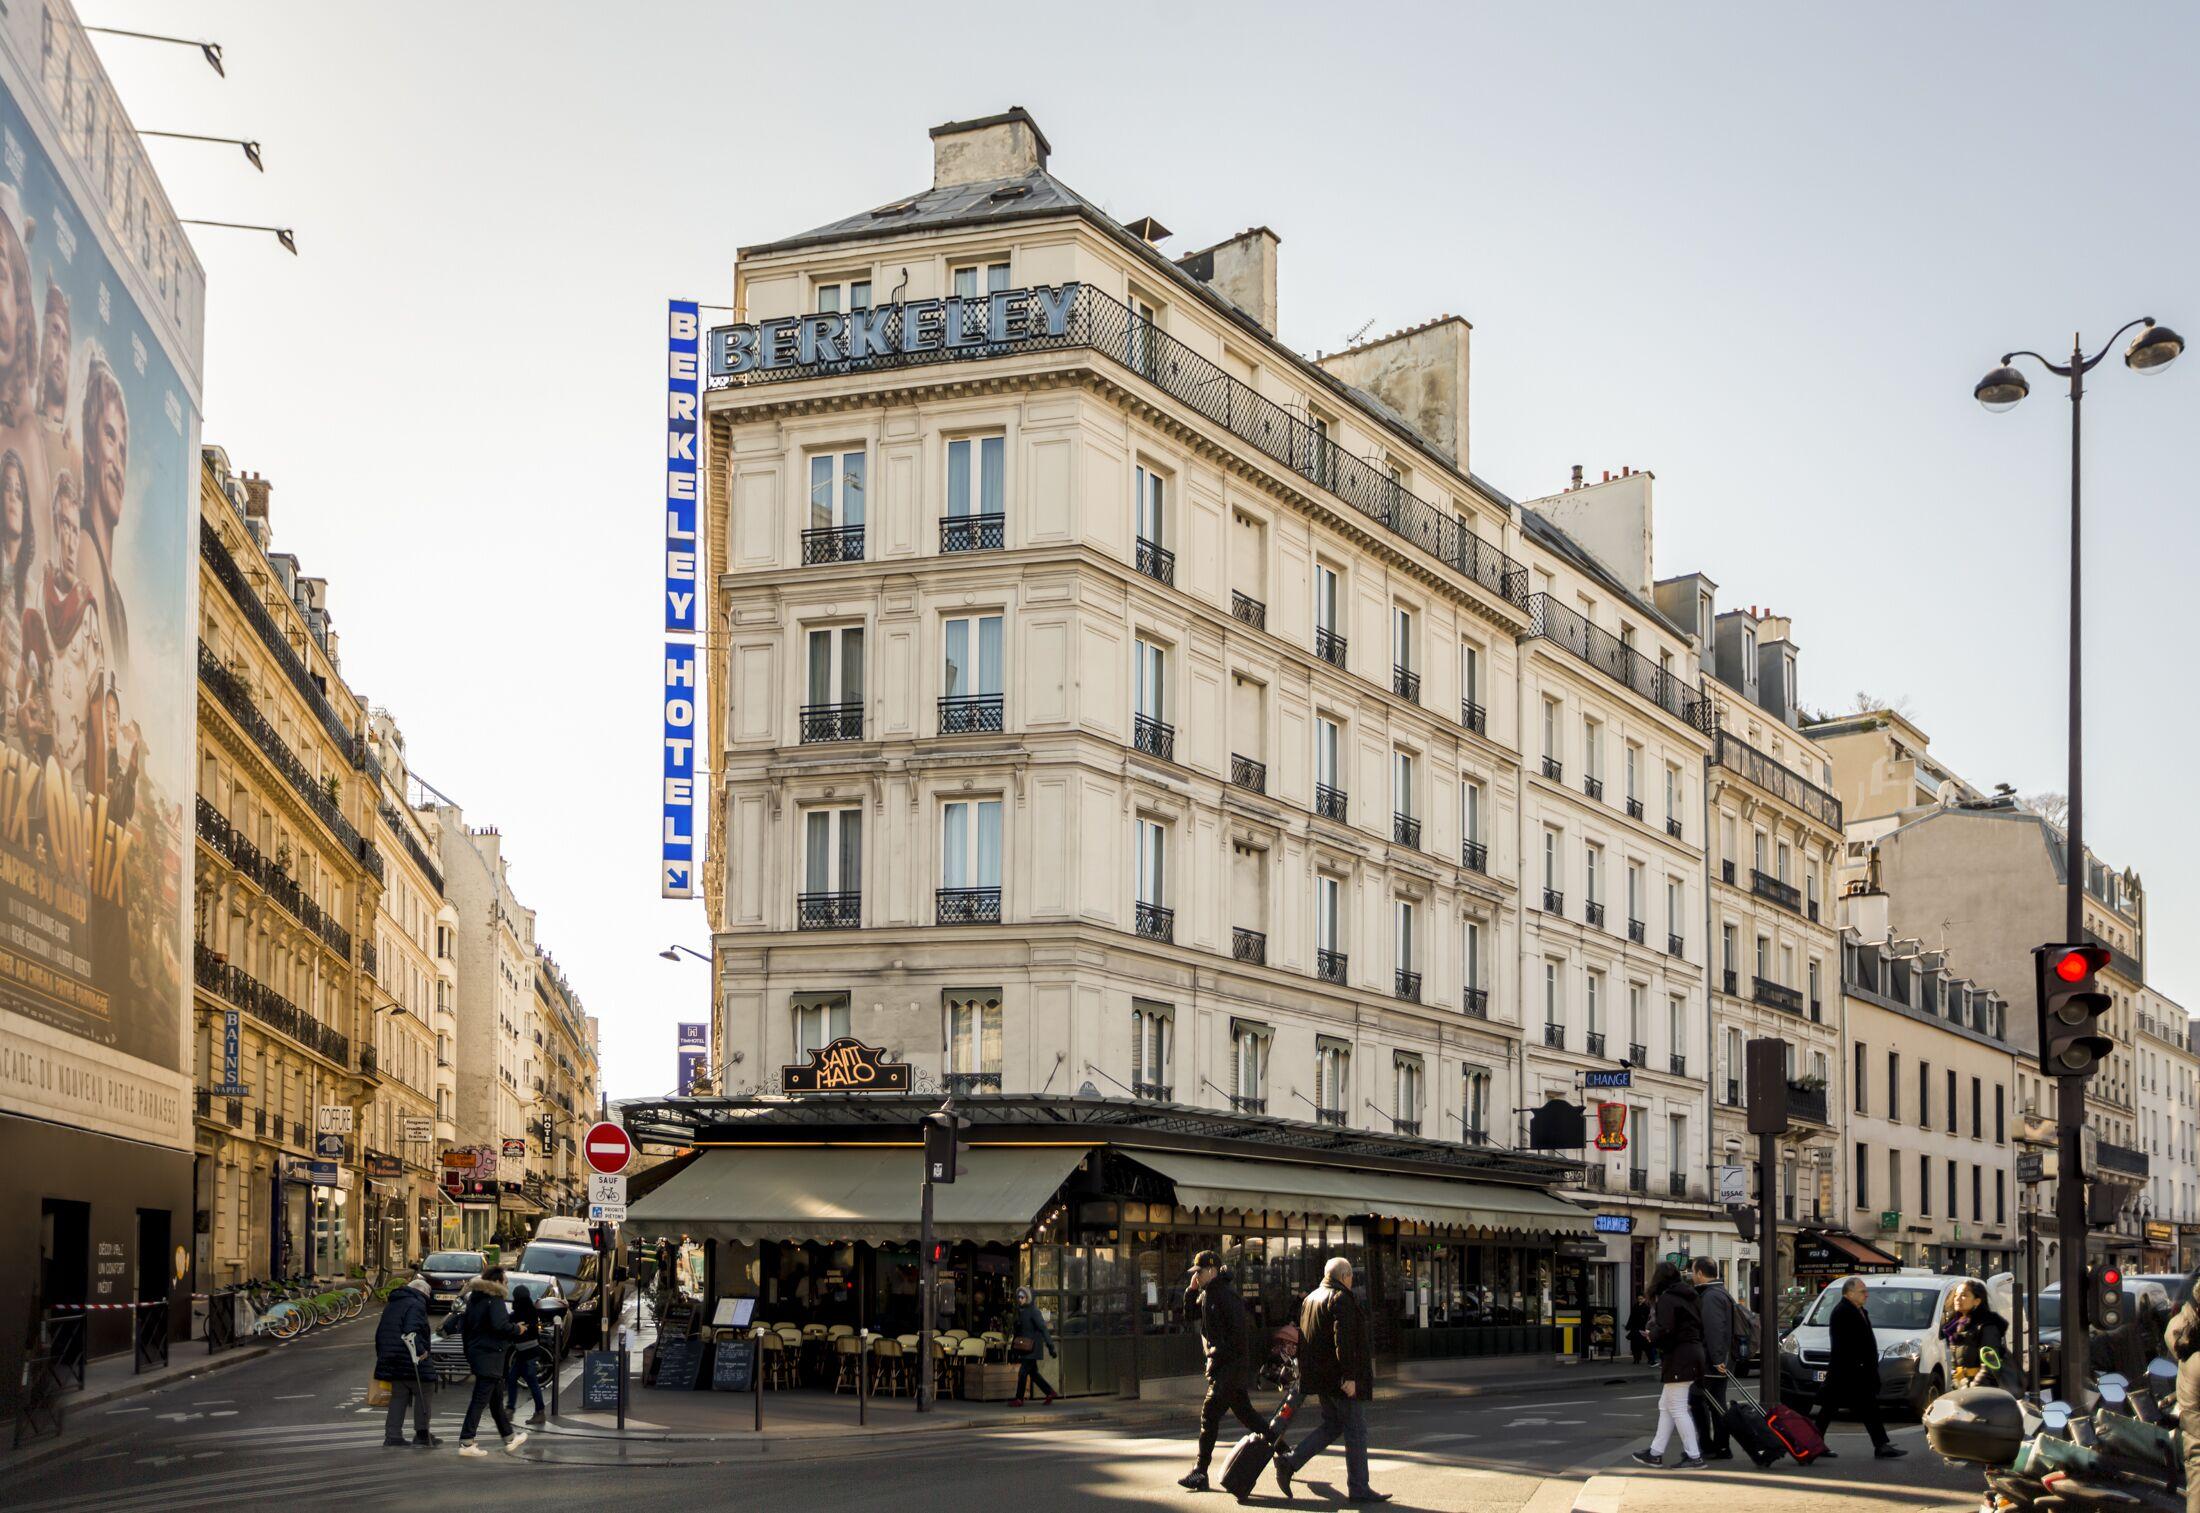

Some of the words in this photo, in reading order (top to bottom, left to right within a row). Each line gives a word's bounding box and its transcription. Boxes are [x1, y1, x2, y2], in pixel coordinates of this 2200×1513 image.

[41, 2, 182, 329] PARNASSE
[710, 281, 1082, 378] BERKELEY
[667, 311, 698, 620] BERKELEY
[664, 659, 694, 845] HOTEL
[226, 1014, 238, 1083] BAINS
[40, 1059, 52, 1090] DU
[58, 1064, 103, 1104] NOUVEAU
[108, 1078, 134, 1113] PATHÉ
[139, 1089, 176, 1125] PARNASSE
[215, 1086, 249, 1095] VAPEUR
[816, 1062, 876, 1089] MALO
[1586, 1072, 1629, 1086] CHANGE
[320, 1108, 351, 1131] COIFFURE
[543, 1114, 552, 1151] HOTEL
[598, 1176, 618, 1184] SAUF
[1593, 1215, 1630, 1233] CHANGE
